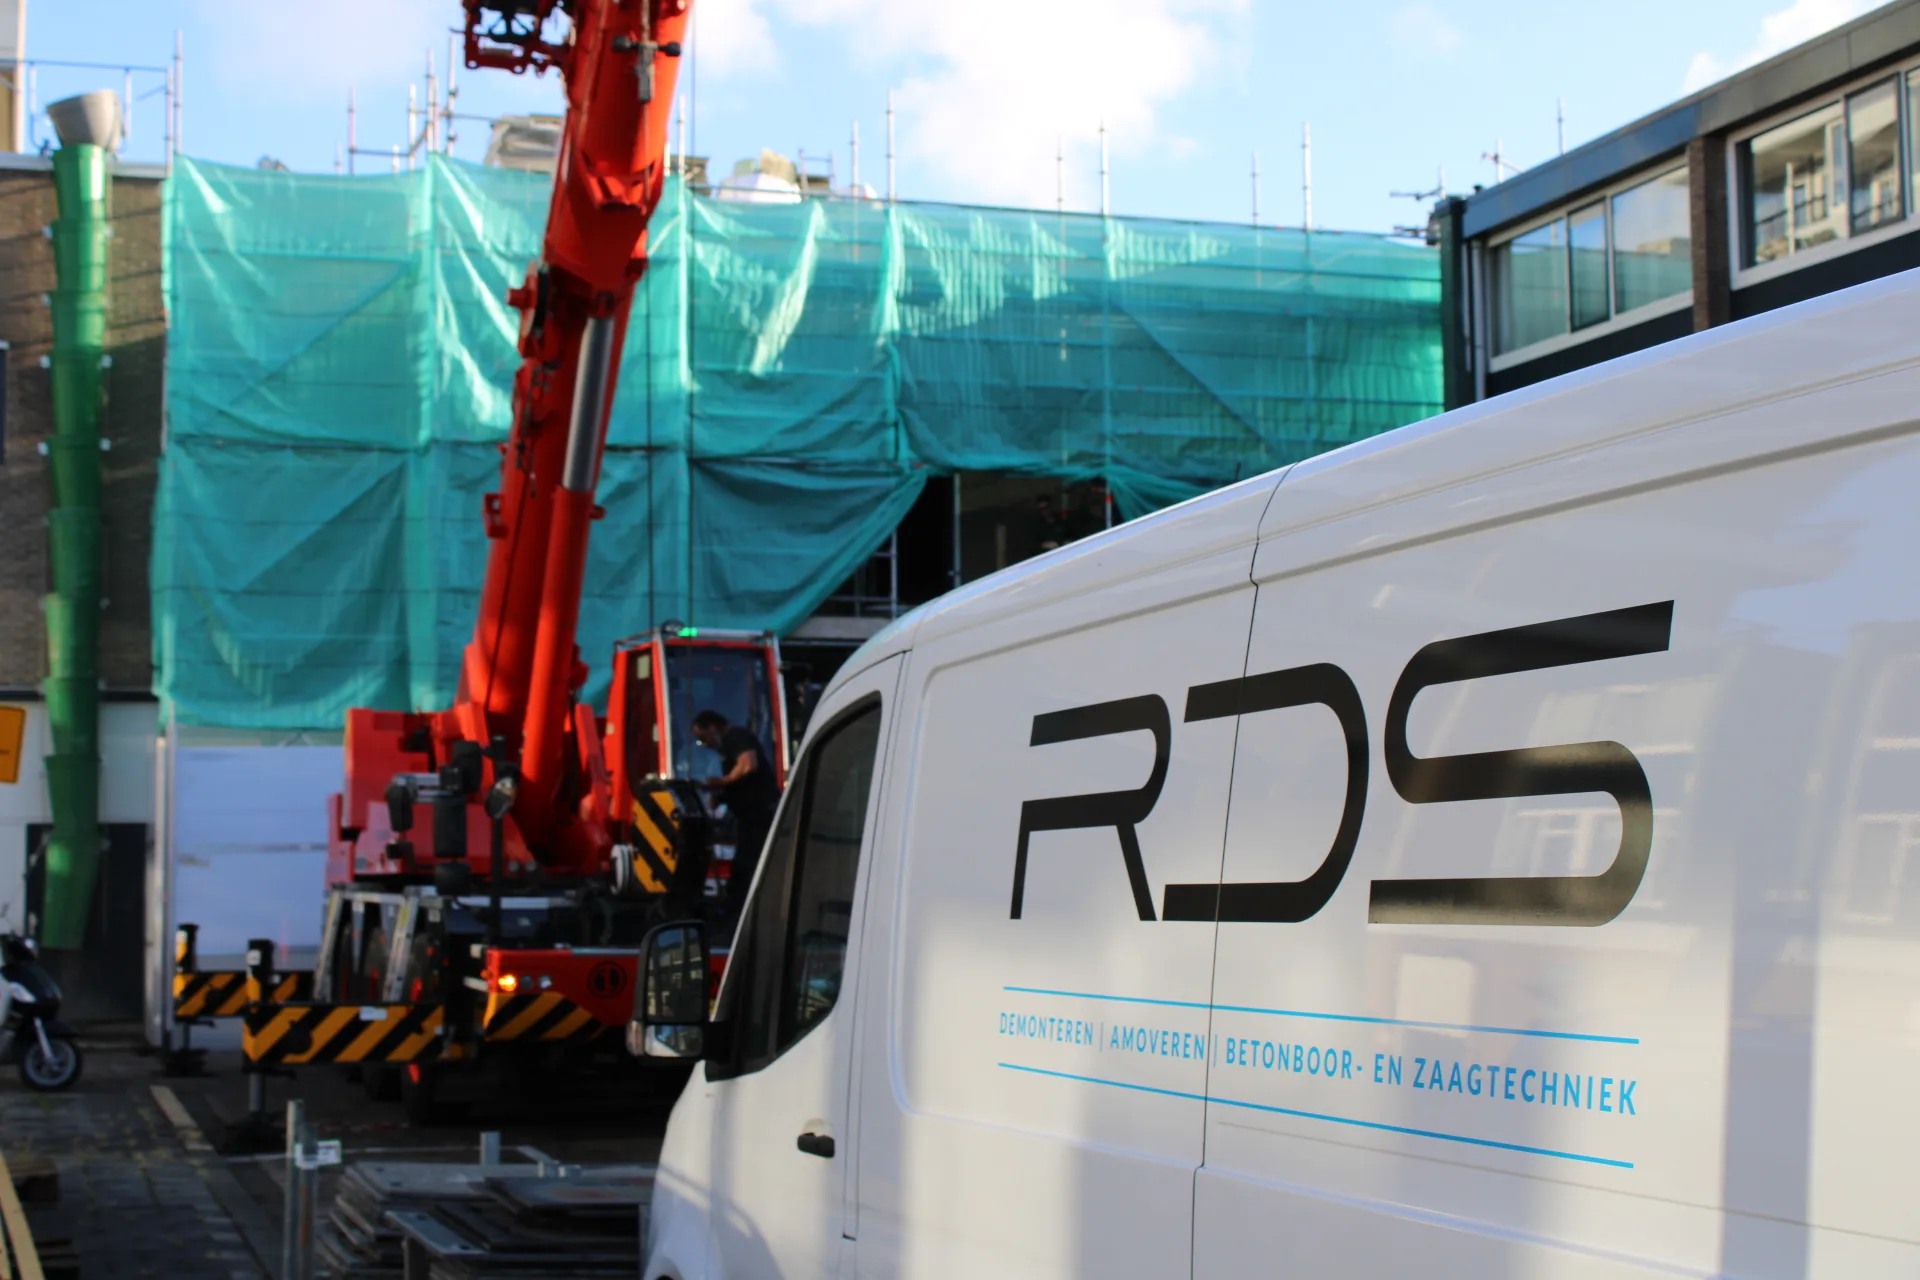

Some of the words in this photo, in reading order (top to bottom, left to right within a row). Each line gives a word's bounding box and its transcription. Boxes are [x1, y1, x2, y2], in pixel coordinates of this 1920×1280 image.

[1010, 600, 1674, 927] RDS
[999, 1012, 1093, 1046] DEMONTEREN
[1110, 1024, 1206, 1061] AMOVEREN
[1226, 1037, 1363, 1080] BETONBOOR-
[1373, 1053, 1403, 1086] EN
[1413, 1057, 1637, 1116] ZAAGTECHNIEK
